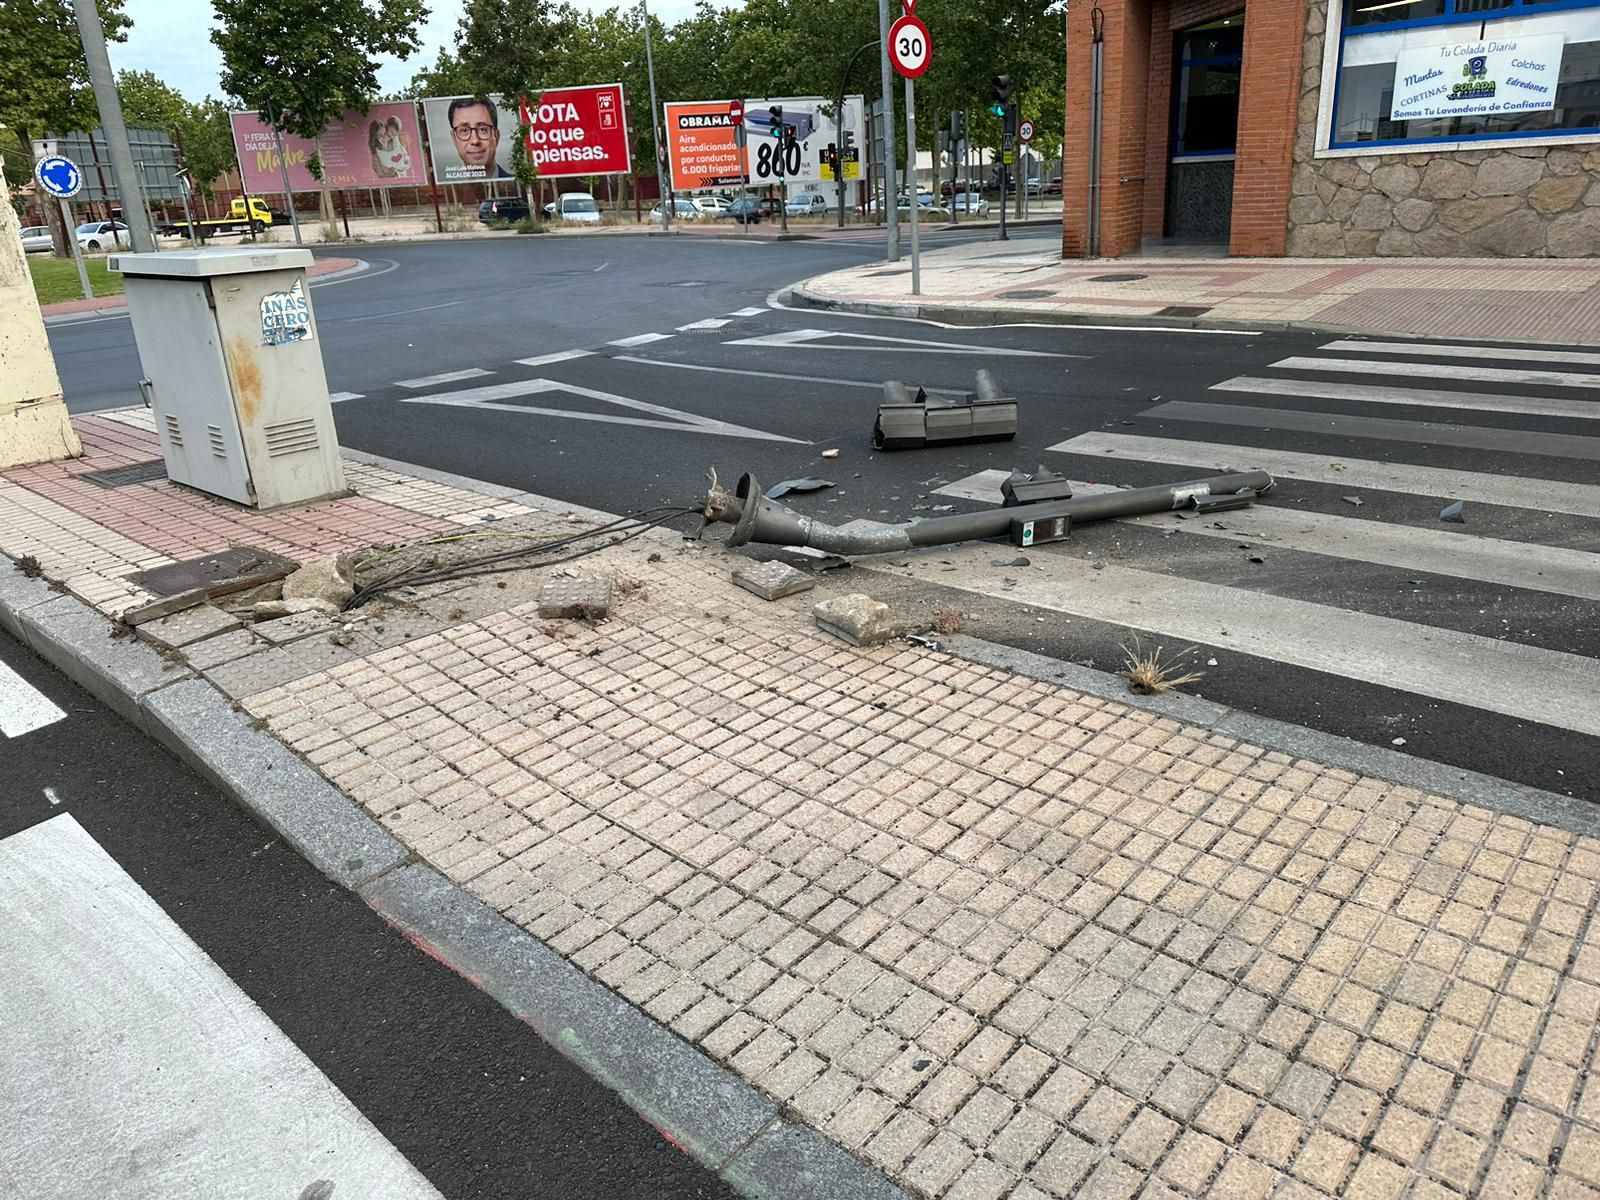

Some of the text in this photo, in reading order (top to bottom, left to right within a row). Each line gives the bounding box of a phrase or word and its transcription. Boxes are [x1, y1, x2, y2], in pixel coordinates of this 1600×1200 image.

[900, 38, 922, 58] 30
[1440, 42, 1517, 58] Tu Colada Diaria
[1512, 58, 1546, 72] Colchas
[1404, 68, 1444, 87] Mantas
[1506, 76, 1549, 94] Edredones
[1452, 81, 1496, 93] COLADA
[1400, 84, 1448, 107] CORTINAS
[525, 102, 580, 124] VOTA
[1394, 100, 1552, 118] Somos Tu Lavandería de Confianza
[680, 116, 734, 127] OBRAMA
[251, 132, 270, 141] FERIA
[530, 126, 584, 145] lo que
[1022, 127, 1031, 136] 30
[268, 142, 277, 150] LA
[680, 136, 696, 144] Aire
[680, 142, 737, 152] acondicionado
[257, 144, 305, 173] Madre
[532, 145, 609, 167] piensas.
[681, 154, 736, 165] por conductos
[682, 165, 707, 174] 6.000
